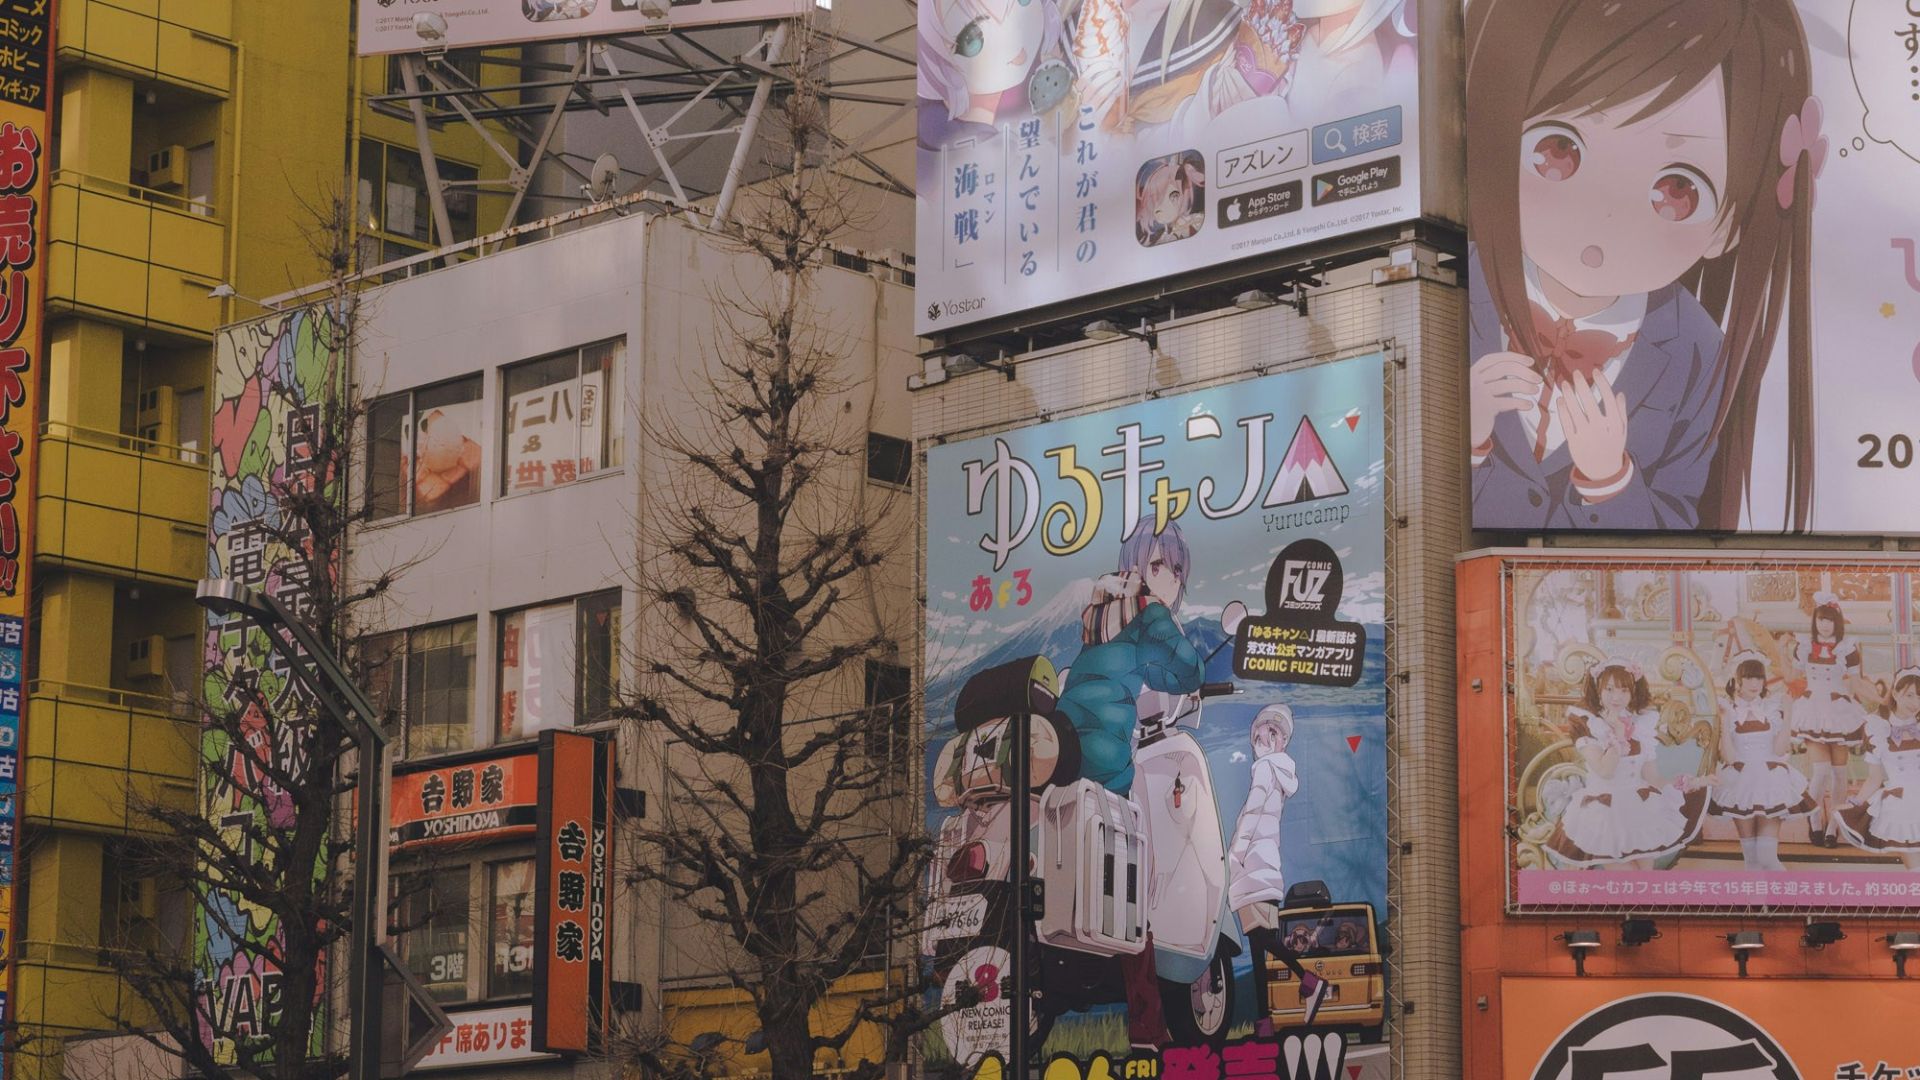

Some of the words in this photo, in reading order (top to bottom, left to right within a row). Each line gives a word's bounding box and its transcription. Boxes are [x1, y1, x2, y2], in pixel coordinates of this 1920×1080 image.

[1353, 119, 1389, 147] 検索
[1224, 146, 1294, 178] アズレン
[1337, 172, 1369, 186] Google
[1369, 166, 1389, 179] Play
[984, 173, 995, 224] ロマン
[1019, 118, 1041, 277] 望んでいる
[1076, 106, 1098, 263] これが君の
[1248, 195, 1266, 208] App
[1267, 190, 1291, 203] Store
[1337, 181, 1379, 197] で手に入れよう
[1248, 201, 1289, 218] からダウンロード
[942, 297, 986, 317] Yostar
[1857, 434, 1920, 470] 20
[1263, 503, 1350, 532] Yurucamp
[1306, 561, 1333, 570] COMIC
[1279, 560, 1331, 608] FUZ
[421, 763, 505, 816] 吉野家
[423, 811, 500, 837] YOSHINOYA
[557, 820, 588, 963] 吉野家
[591, 829, 605, 961] YOSHINOYA
[430, 952, 464, 981] 3階
[203, 969, 290, 1041] VAP
[961, 1007, 982, 1018] NEW
[983, 1005, 1010, 1017] COMIC
[968, 1018, 1004, 1031] RELEASE!
[1125, 1059, 1157, 1080] FRI
